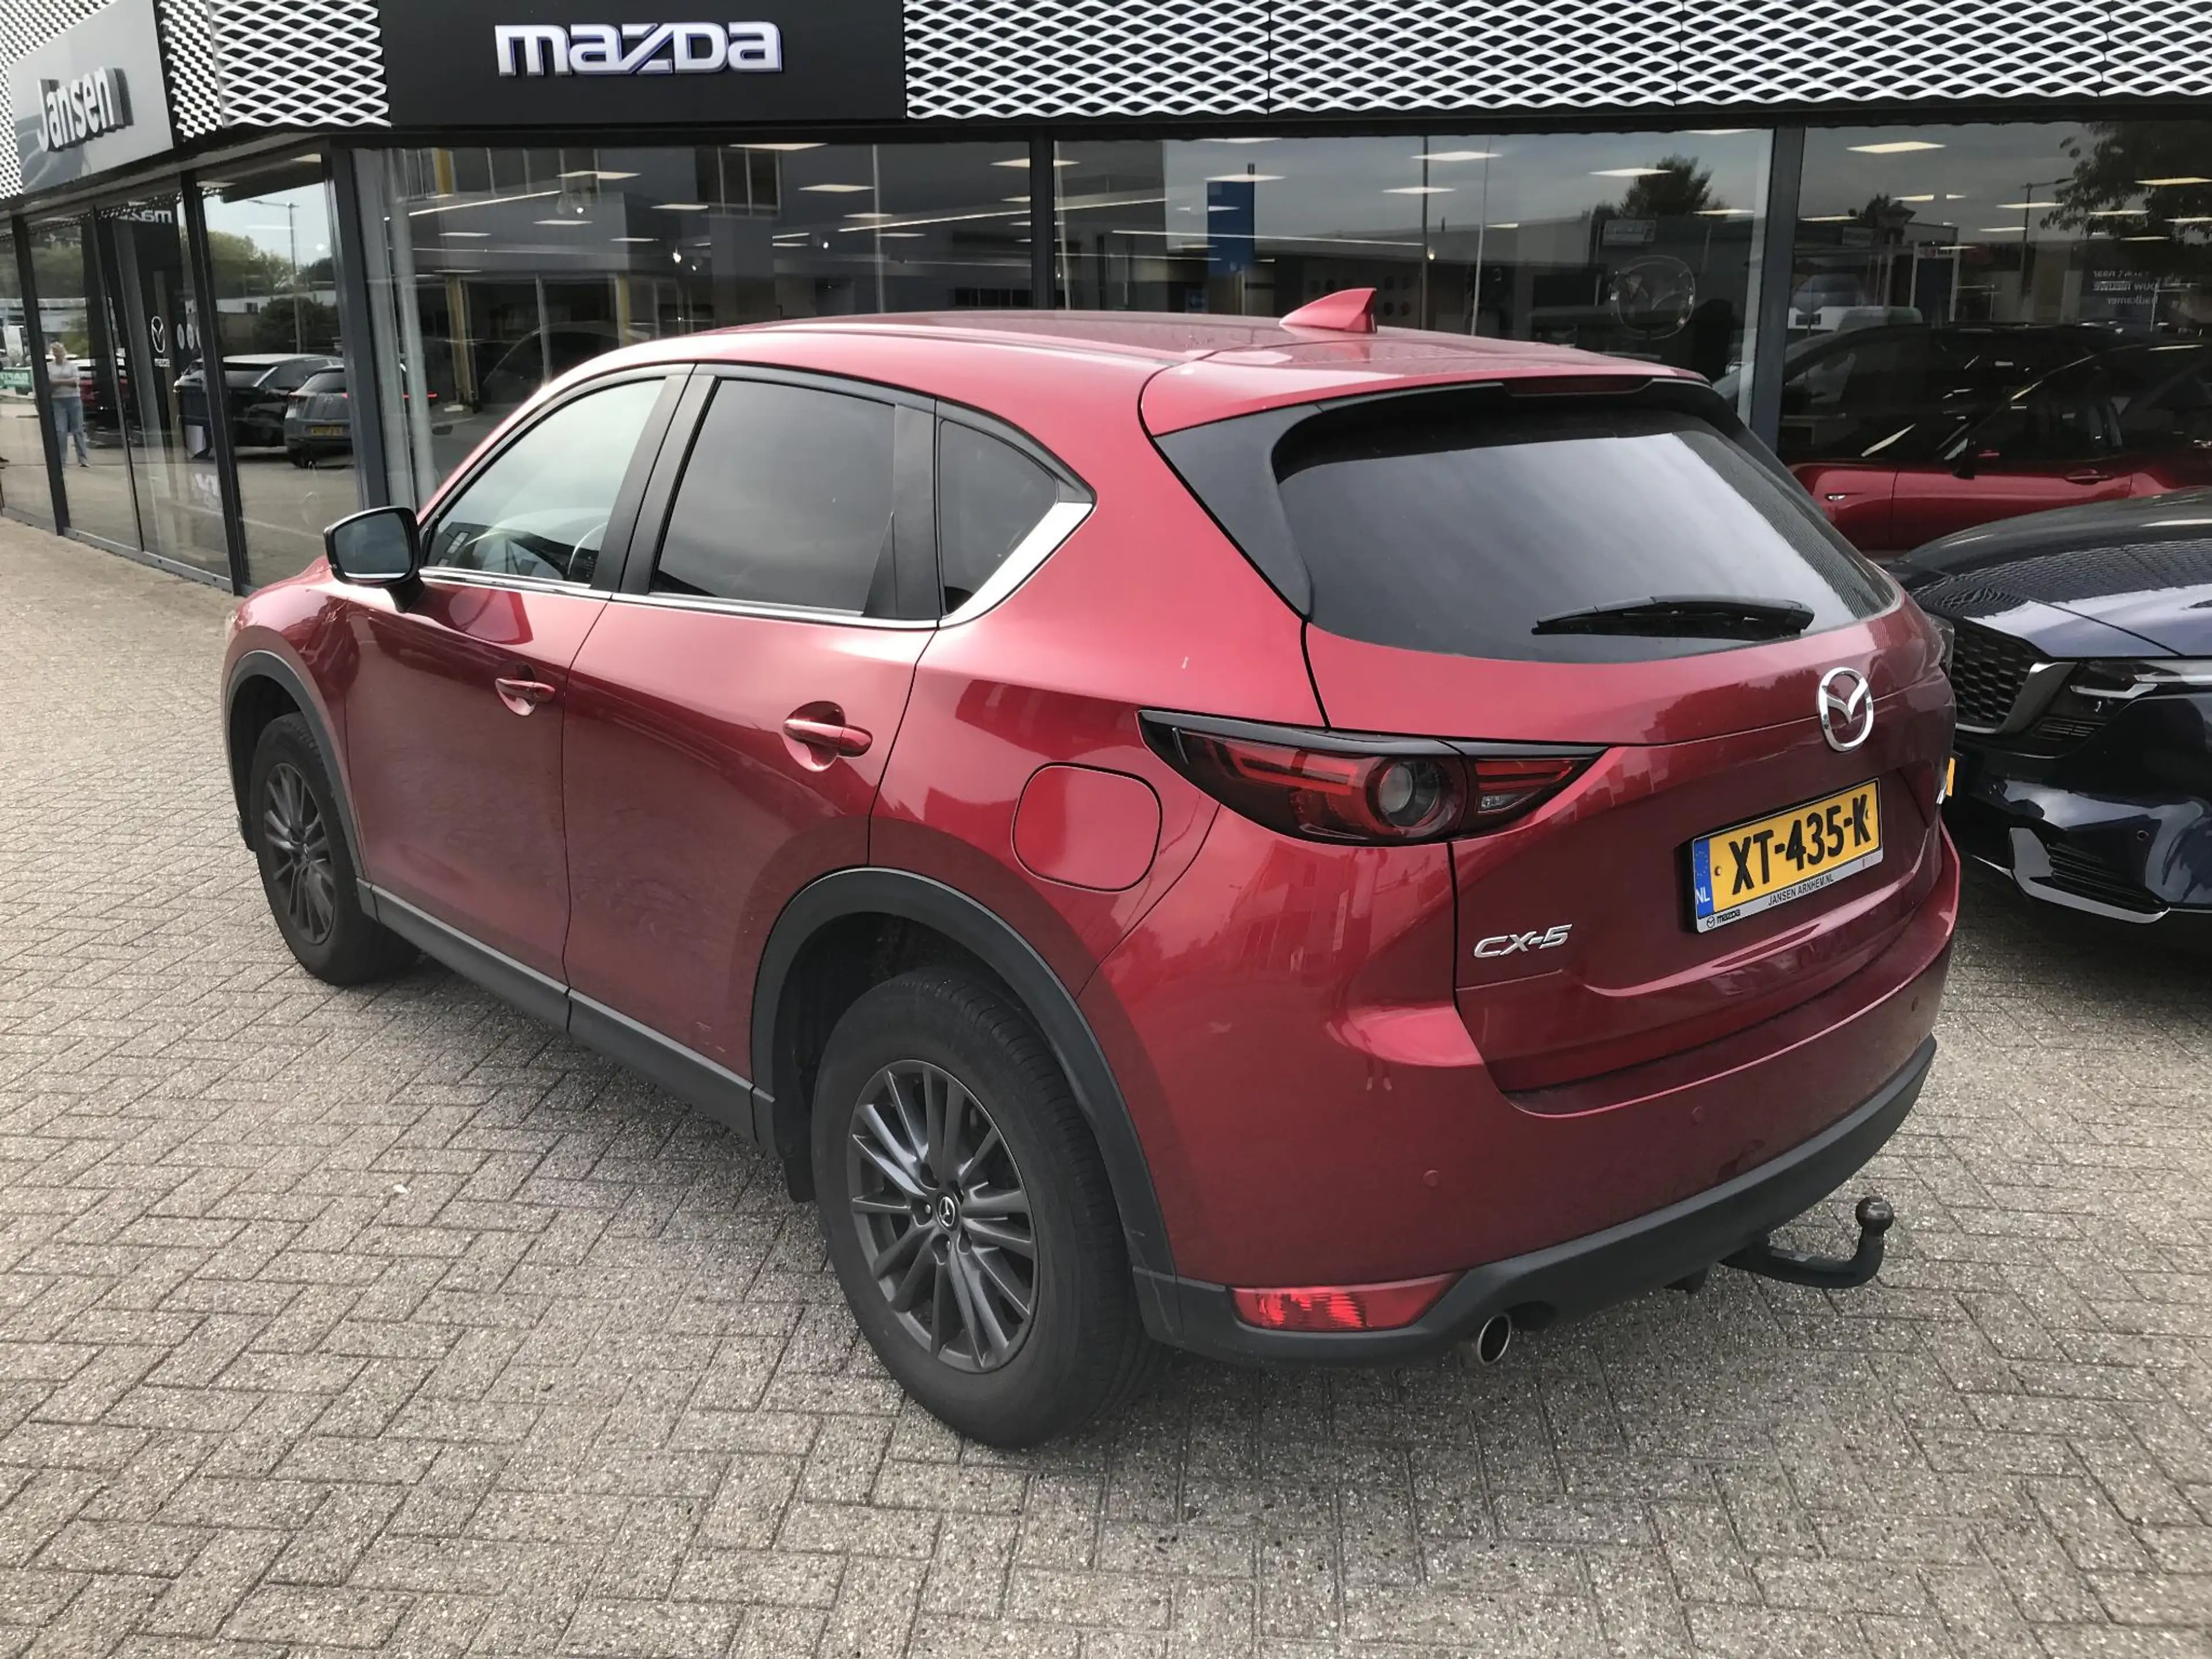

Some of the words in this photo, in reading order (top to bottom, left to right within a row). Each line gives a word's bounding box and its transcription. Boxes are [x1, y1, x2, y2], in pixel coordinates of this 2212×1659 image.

[495, 21, 782, 75] mazda
[37, 67, 119, 151] Jansen
[1729, 794, 1872, 895] XT-435-K
[1695, 887, 1710, 904] NL
[1768, 888, 1796, 906] JANSEN
[1797, 873, 1834, 895] ARNHEM.NL
[1717, 909, 1741, 924] mazda
[1474, 923, 1572, 958] CX-5
